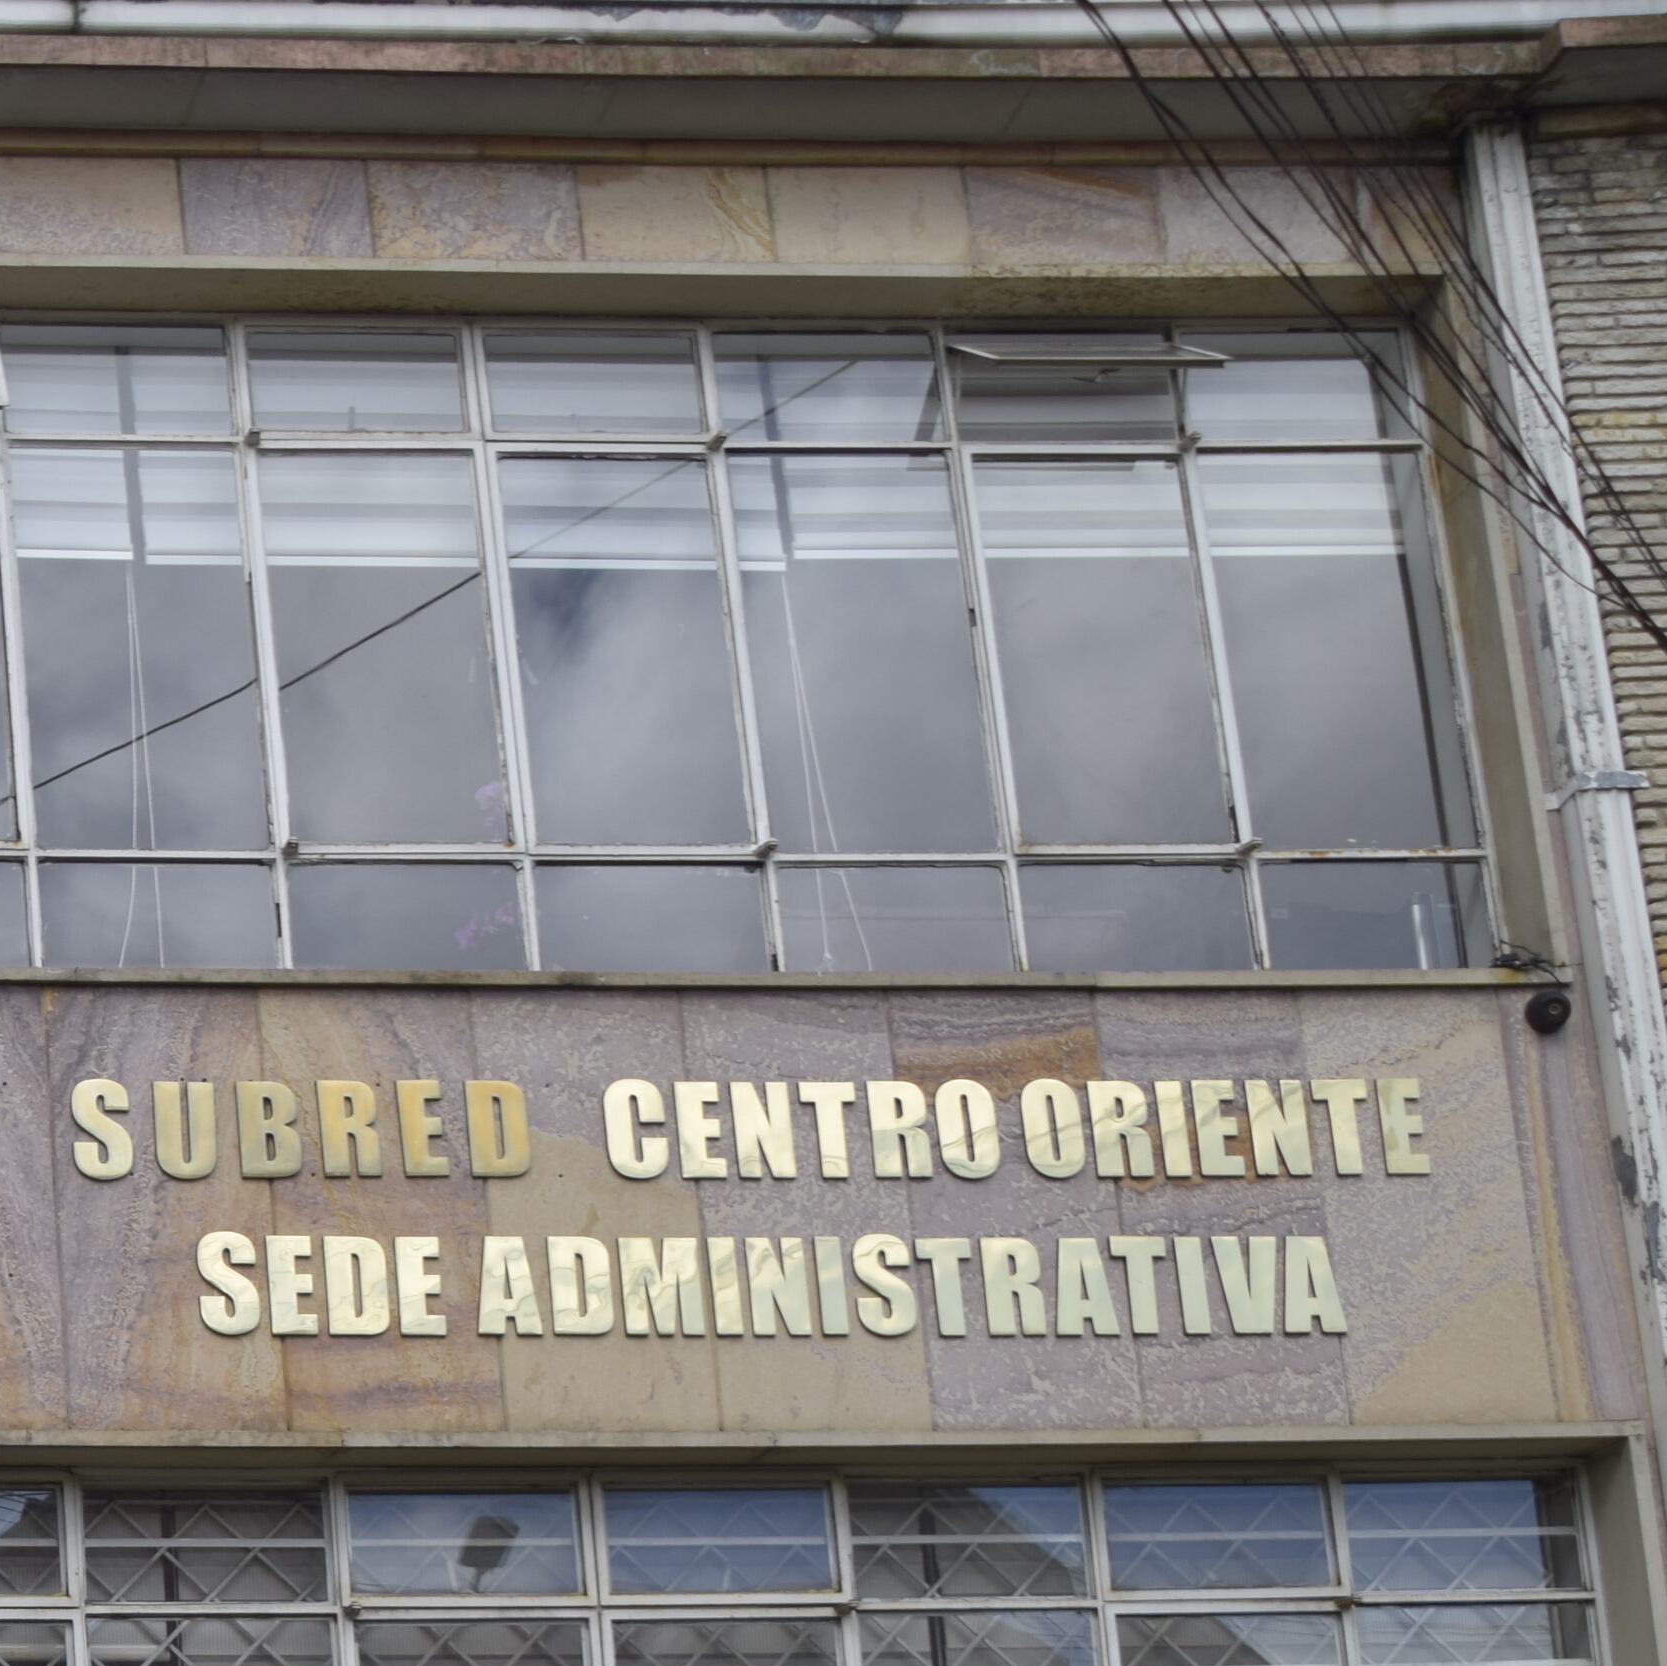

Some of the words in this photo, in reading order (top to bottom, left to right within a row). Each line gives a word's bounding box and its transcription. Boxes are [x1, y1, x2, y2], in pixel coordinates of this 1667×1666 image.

[70, 1078, 531, 1181] SUBRED
[602, 1078, 1002, 1181] CENTRO
[1019, 1077, 1432, 1181] ORIENTE
[196, 1231, 448, 1337] SEDE
[477, 1233, 1348, 1338] ADMINISTRATIVA
